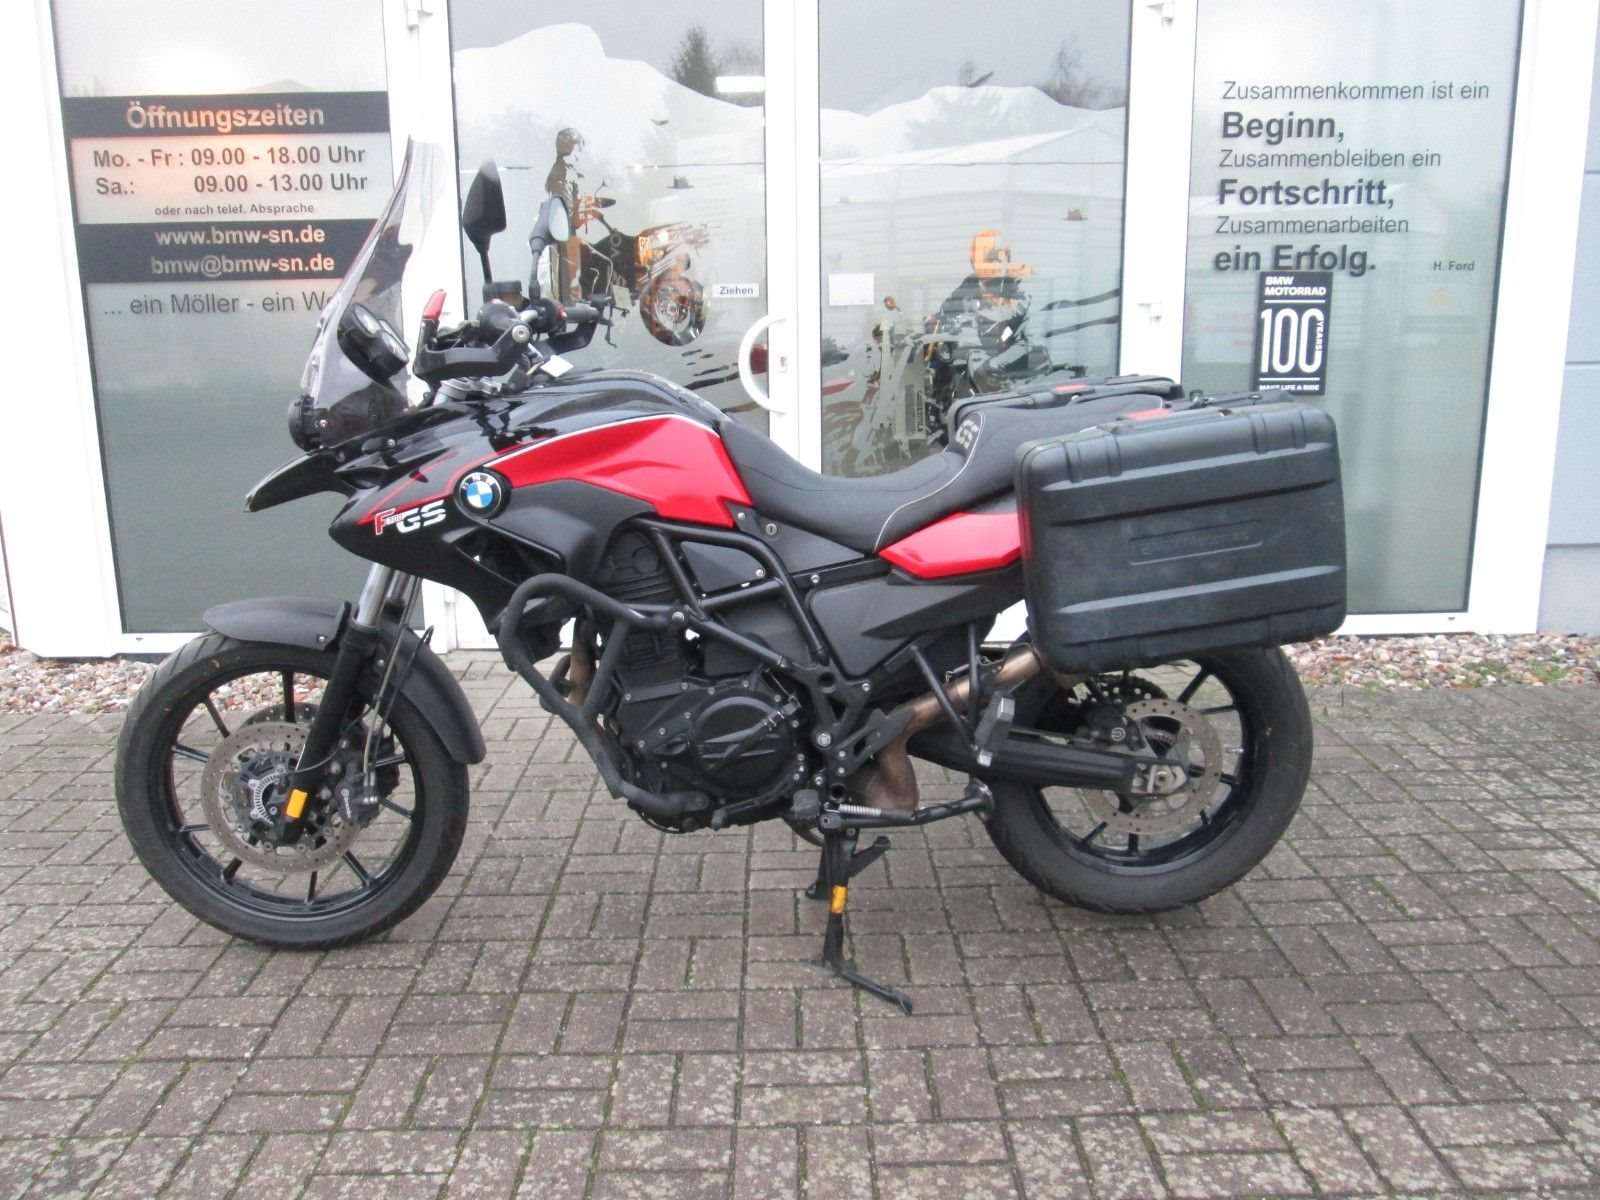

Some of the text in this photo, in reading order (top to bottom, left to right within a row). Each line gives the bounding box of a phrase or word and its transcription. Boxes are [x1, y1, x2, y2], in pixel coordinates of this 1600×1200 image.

[1222, 81, 1490, 100] Zusammenkommen ist ein
[127, 101, 325, 132] Öffnungszeiten
[1222, 111, 1345, 145] Beginn,
[93, 149, 130, 167] Mo.
[191, 148, 244, 166] 09.00
[267, 146, 320, 164] 18.00
[328, 145, 366, 163] Uhr
[1219, 149, 1441, 167] Zusammenbleiben ein
[95, 177, 134, 195] Sa.:
[194, 175, 248, 193] 09.00
[270, 174, 323, 191] 13.00
[330, 173, 368, 190] Uhr
[1219, 178, 1394, 209] Fortschritt,
[154, 203, 315, 215] oder nach telef. Absprache
[155, 225, 326, 246] www.bmw-sn.de
[1215, 215, 1409, 234] Zusammenarbeiten
[152, 253, 335, 277] bmw@bmw-sn.de
[1214, 244, 1376, 277] ein Erfolg.
[1433, 260, 1475, 271] H. Ford
[719, 286, 754, 295] Ziehen
[1264, 286, 1327, 296] MOTORRAD
[1265, 276, 1294, 285] BMW
[130, 294, 162, 314] ein
[170, 293, 239, 314] Möller
[262, 292, 295, 312] ein
[1260, 307, 1325, 373] 100
[396, 499, 447, 533] GS
